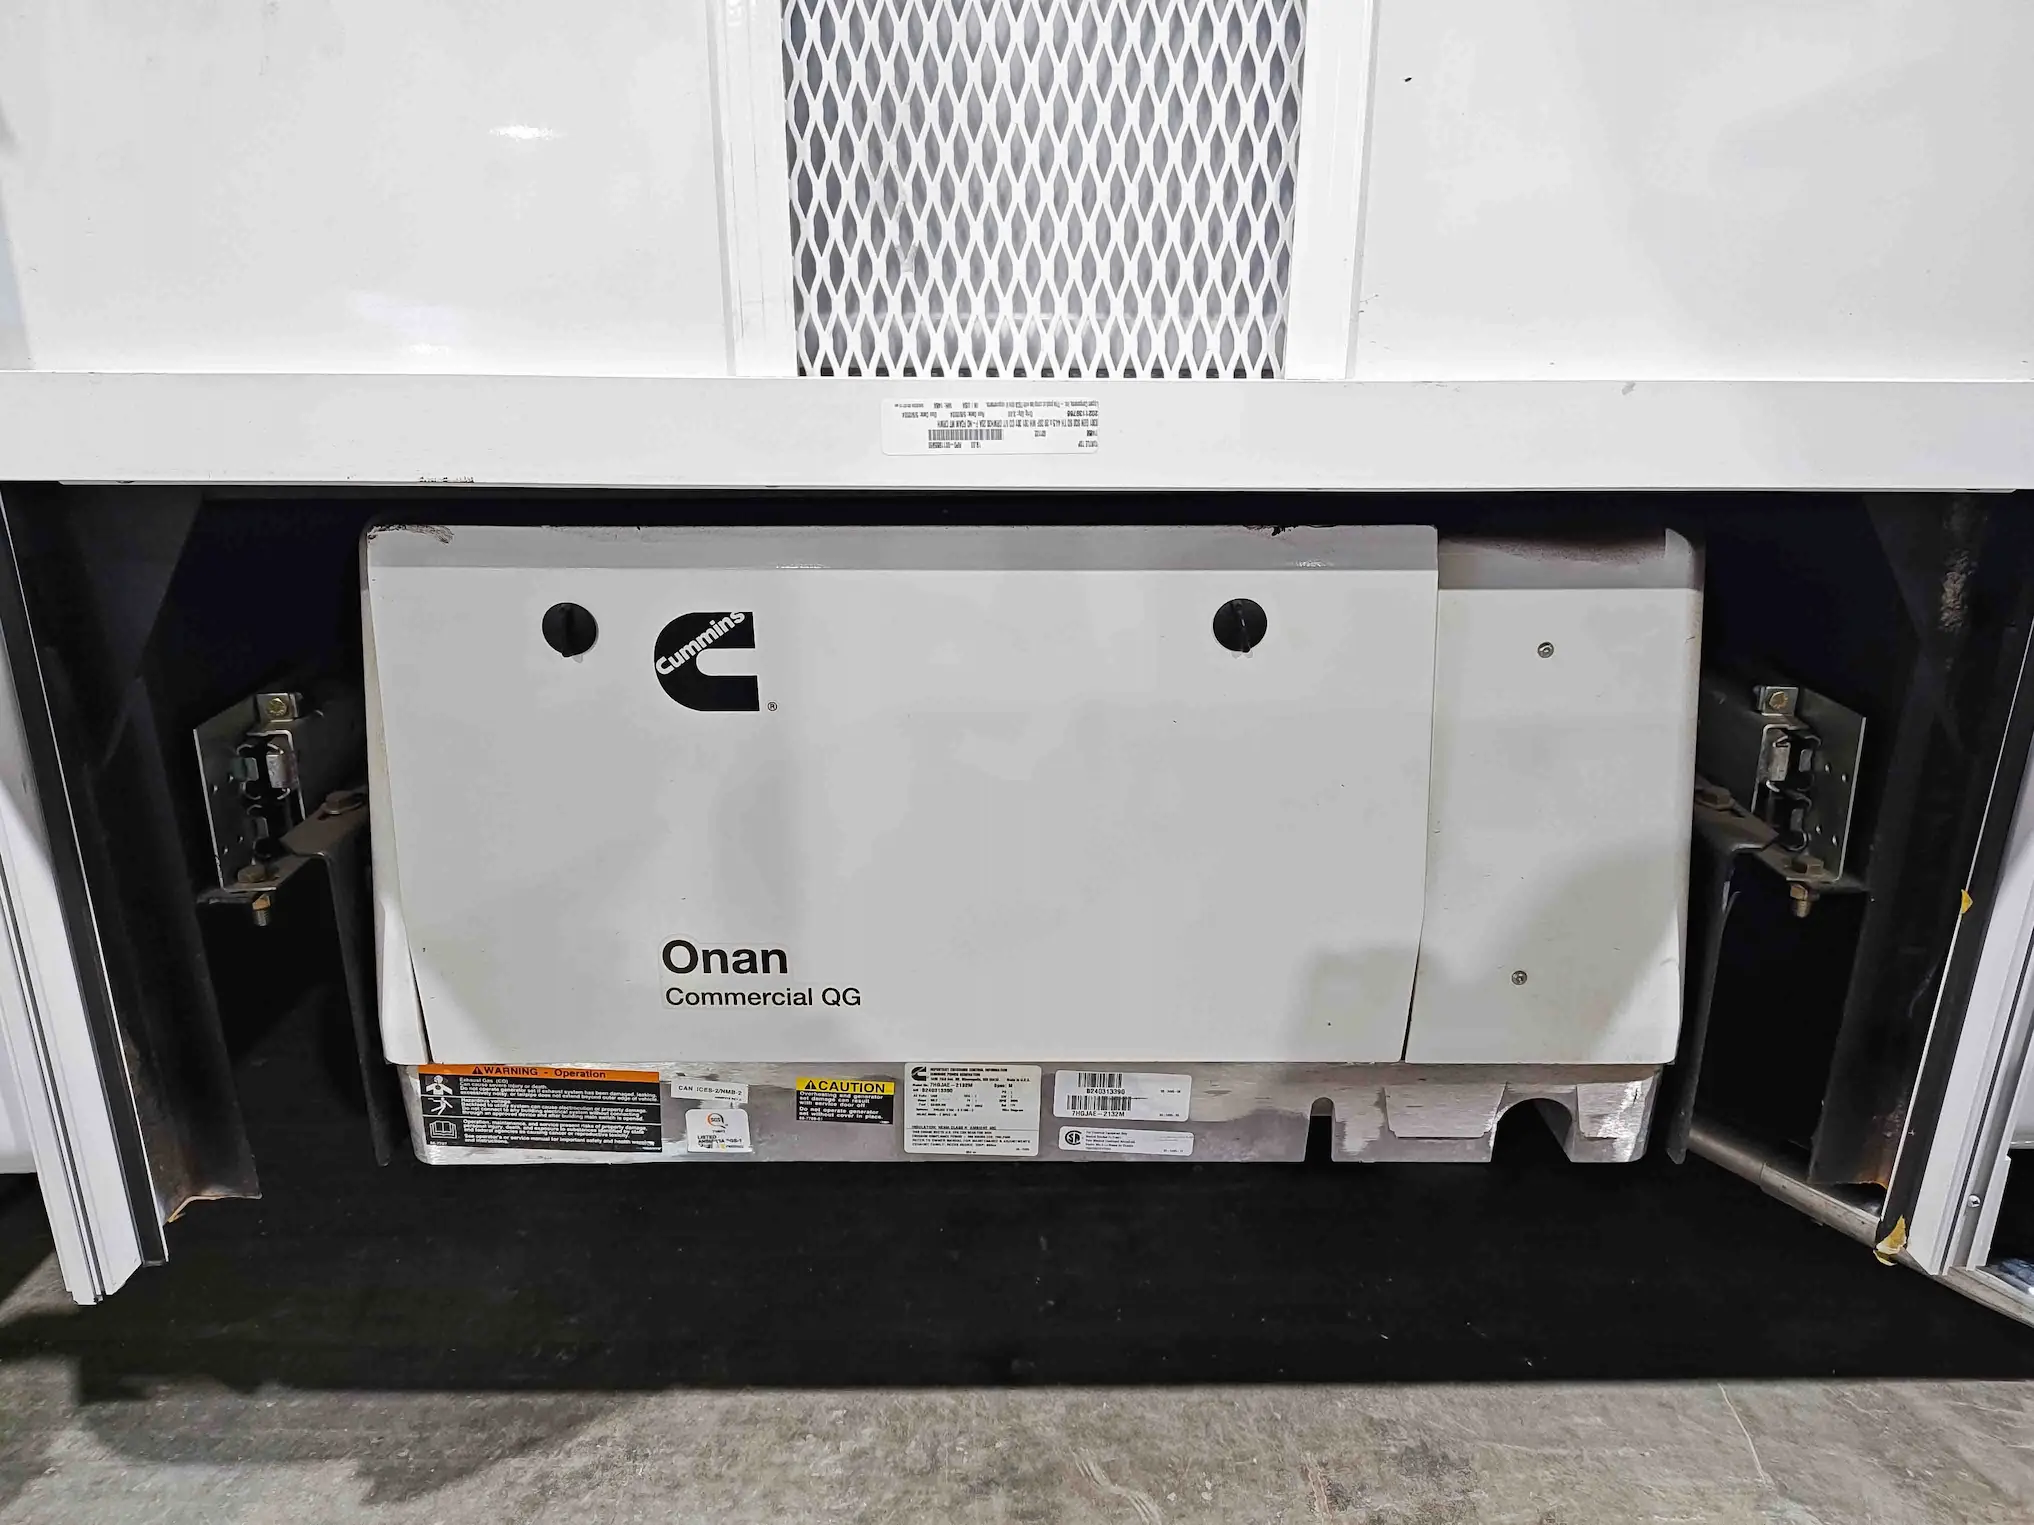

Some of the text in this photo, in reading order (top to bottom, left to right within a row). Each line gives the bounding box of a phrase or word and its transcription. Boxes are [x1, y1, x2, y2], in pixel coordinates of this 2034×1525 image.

[656, 612, 745, 674] Cummins
[662, 940, 788, 974] Onan
[666, 988, 861, 1006] Commercial QG
[484, 1067, 606, 1078] WARNING Operation
[696, 1087, 742, 1095] ICES-2/NMB-2
[818, 1080, 885, 1093] CAUTION
